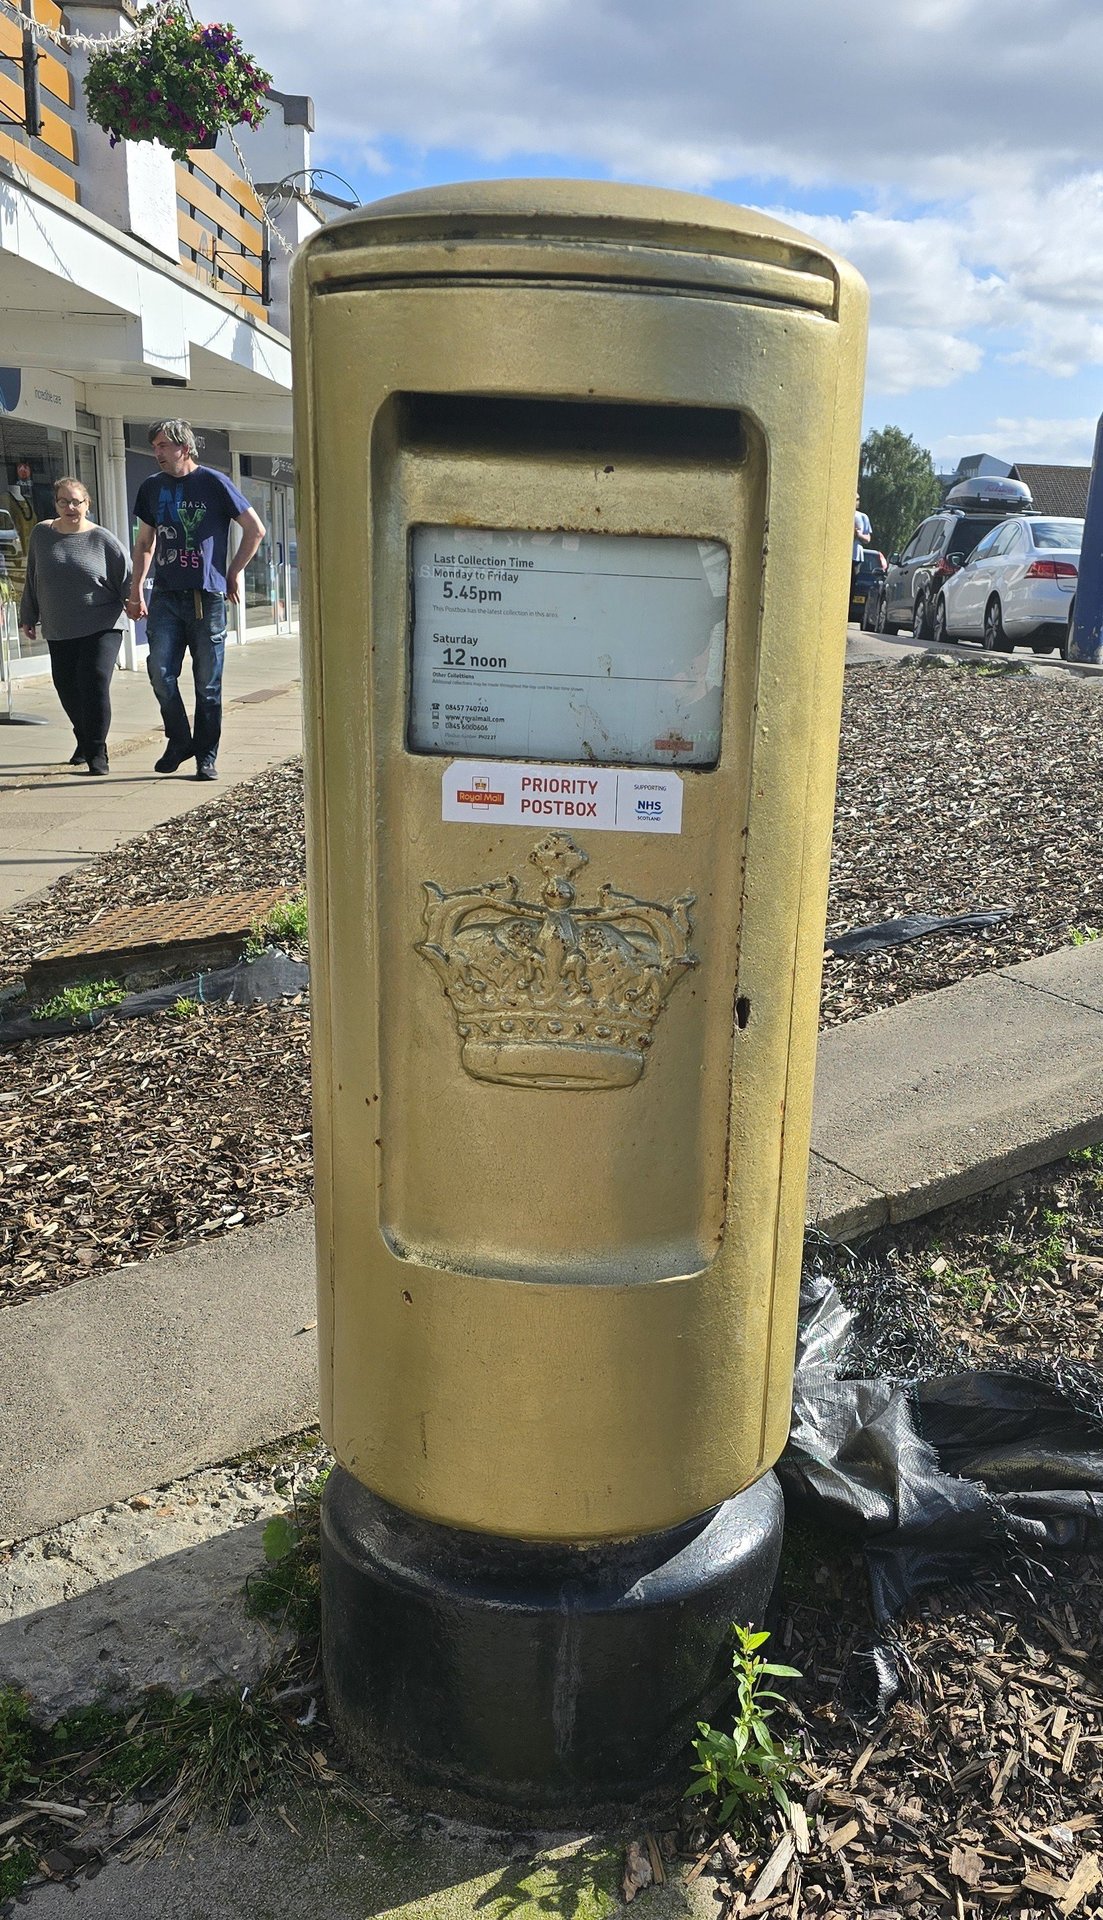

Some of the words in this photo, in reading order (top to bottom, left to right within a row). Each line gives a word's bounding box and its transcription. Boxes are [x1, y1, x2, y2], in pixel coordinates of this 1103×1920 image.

[176, 501, 207, 509] TRACK
[176, 508, 207, 550] Y
[179, 549, 204, 557] TEAM
[434, 553, 455, 565] Last
[458, 554, 507, 568] Collection
[509, 557, 534, 569] Time
[434, 568, 473, 582] Monday
[475, 570, 486, 581] to
[488, 571, 519, 584] Friday
[443, 581, 502, 603] 5.45pm
[503, 609, 529, 617] collection
[433, 633, 478, 646] Saturday
[443, 648, 466, 666] 12
[470, 655, 507, 668] noon
[445, 715, 505, 724] www.royalmail.com
[462, 723, 488, 731] 6000606
[521, 777, 598, 795] PRIORITY
[633, 783, 667, 792] SUPPORTING
[459, 792, 482, 803] Royal
[484, 793, 503, 803] Mail
[521, 799, 597, 817] POSTBOX
[637, 800, 662, 811] NHS
